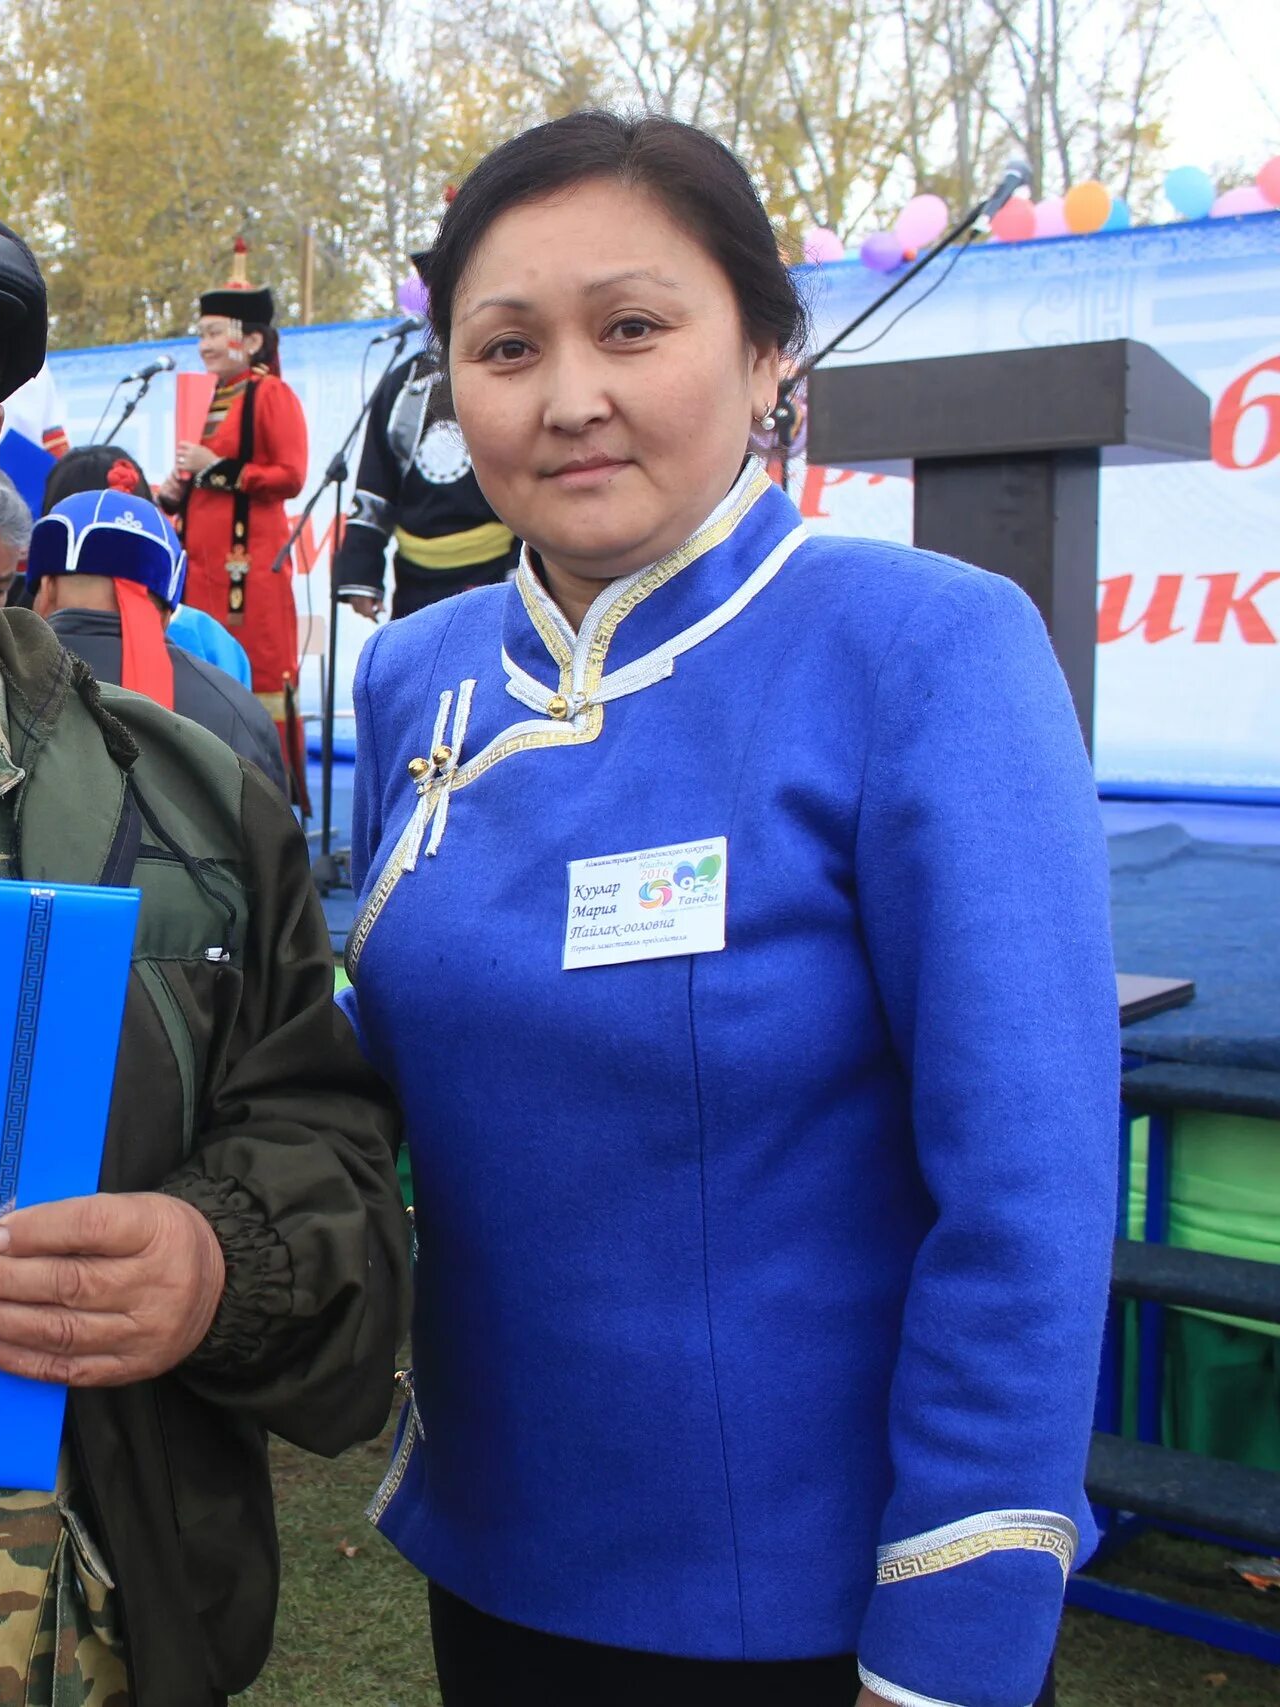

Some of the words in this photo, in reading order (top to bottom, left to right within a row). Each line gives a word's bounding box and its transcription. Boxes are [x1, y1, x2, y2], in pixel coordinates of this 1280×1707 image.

[640, 868, 669, 881] 2016
[574, 882, 621, 900] Куулар
[678, 893, 718, 905] Танды
[572, 904, 617, 920] Мария
[570, 918, 675, 939] Пайлак-ооловна
